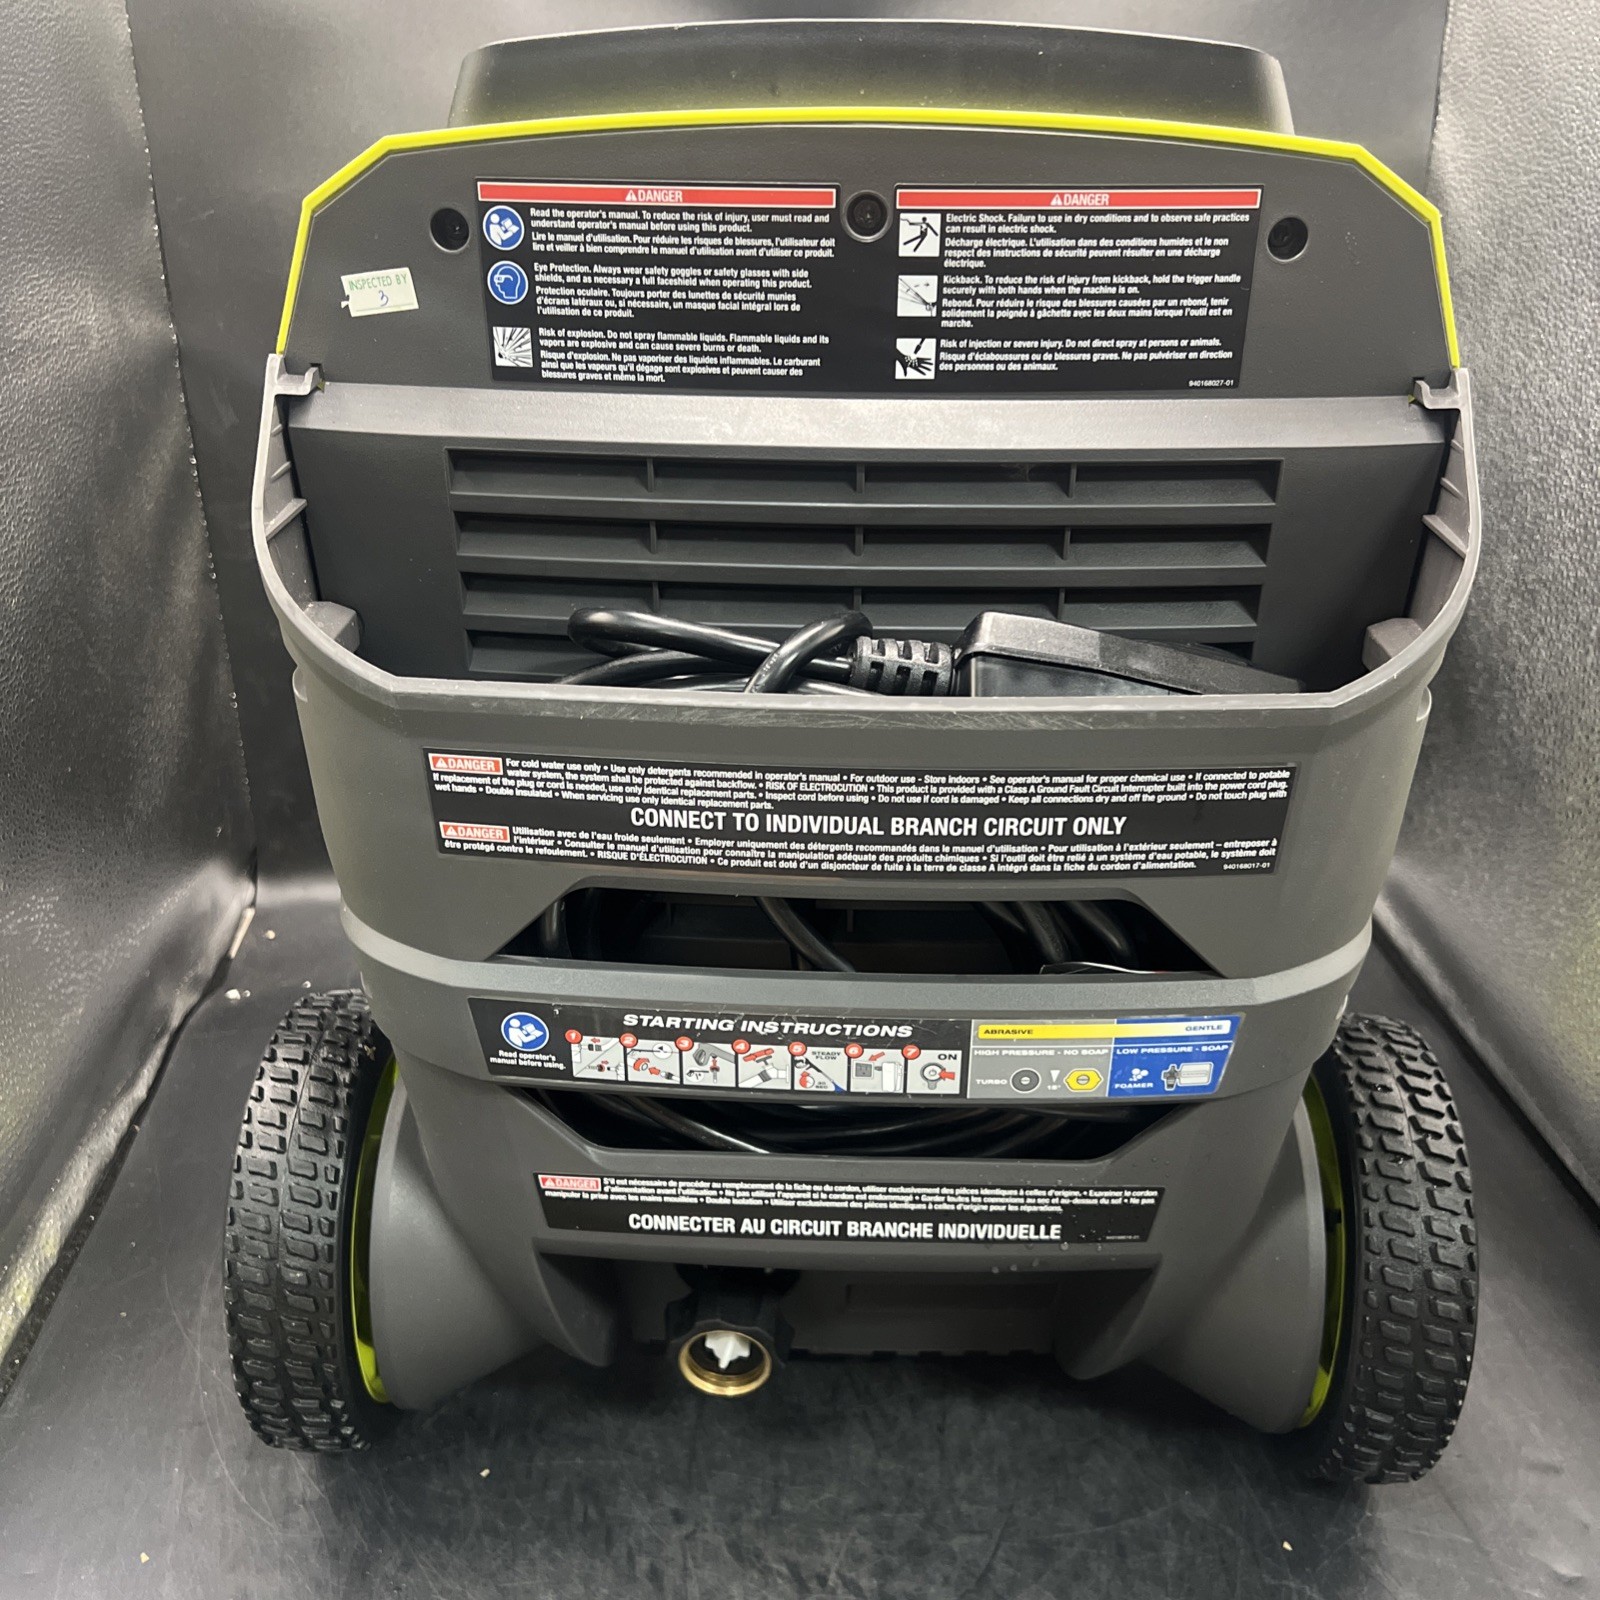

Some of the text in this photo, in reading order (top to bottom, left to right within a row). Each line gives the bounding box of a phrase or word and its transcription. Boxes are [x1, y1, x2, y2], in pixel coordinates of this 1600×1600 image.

[638, 190, 683, 203] DANGER
[1063, 193, 1110, 206] DANGER
[530, 208, 550, 218] Read
[552, 209, 565, 218] the
[566, 209, 607, 221] operator's
[608, 210, 640, 220] manual.
[642, 211, 651, 220] To
[653, 211, 680, 221] reduce
[682, 212, 695, 221] the
[697, 212, 713, 221] risk
[714, 212, 723, 221] of
[725, 212, 750, 224] injury,
[771, 213, 792, 222] must
[793, 214, 812, 223] read
[814, 214, 830, 223] and
[945, 214, 976, 223] Electric
[978, 214, 1006, 223] Shock.
[1007, 214, 1035, 223] Failure
[1037, 214, 1046, 223] to
[1064, 214, 1072, 223] in
[1073, 214, 1087, 224] dry
[1089, 214, 1131, 223] conditions
[1133, 214, 1148, 222] and
[1150, 214, 1159, 222] to
[1160, 213, 1192, 222] observe
[1193, 213, 1211, 222] safe
[1212, 213, 1249, 224] practices
[531, 219, 752, 234] understand operator's manual before using this product.
[534, 263, 809, 279] Eye Protection. Always wear safety goggles or safety glasses with side
[349, 273, 408, 291] INSPECTED BY
[942, 274, 1241, 286] Kickback. To reduce the risk of injury from kickback, hold the trigger handle
[538, 328, 829, 345] Risk of explosion. Do not spray flammable liquids. Flammable liquids and its
[447, 757, 495, 772] DANGER
[505, 759, 519, 768] For
[521, 759, 539, 769] cold
[540, 760, 565, 770] water
[566, 763, 582, 771] use
[583, 762, 601, 774] only
[610, 764, 626, 773] Use
[627, 765, 645, 776] only
[647, 766, 691, 778] detergents
[693, 768, 753, 779] recommended
[754, 771, 763, 780] in
[764, 771, 807, 783] operator's
[808, 772, 840, 782] manual
[850, 774, 864, 783] For
[865, 774, 898, 783] outdoor
[924, 775, 946, 784] Store
[948, 775, 980, 784] indoors
[989, 775, 1005, 784] See
[1007, 775, 1050, 786] operator's
[1051, 774, 1084, 783] manual
[1085, 774, 1098, 783] for
[1099, 775, 1128, 785] proper
[1129, 773, 1168, 782] chemical
[1195, 772, 1201, 781] If
[1202, 771, 1247, 781] connected
[1248, 771, 1257, 780] to
[1258, 770, 1290, 781] potable
[630, 807, 1128, 836] CONNECT TO INDIVIDUAL BRANCH CIRCUIT ONLY
[457, 826, 504, 839] DANGER
[623, 1014, 914, 1037] STARTING INSTRUCTIONS
[1185, 1024, 1223, 1032] GENTLE
[570, 1032, 576, 1040] 1
[498, 1050, 556, 1062] Read operator's
[906, 1048, 917, 1056] 7
[1140, 1046, 1193, 1054] PRESSURE
[489, 1056, 567, 1070] manual before using.
[555, 1178, 597, 1189] DANGER
[628, 1213, 1062, 1240] CONNECTER AU CIRCUIT BRANCHE INDIVIDUELLE
